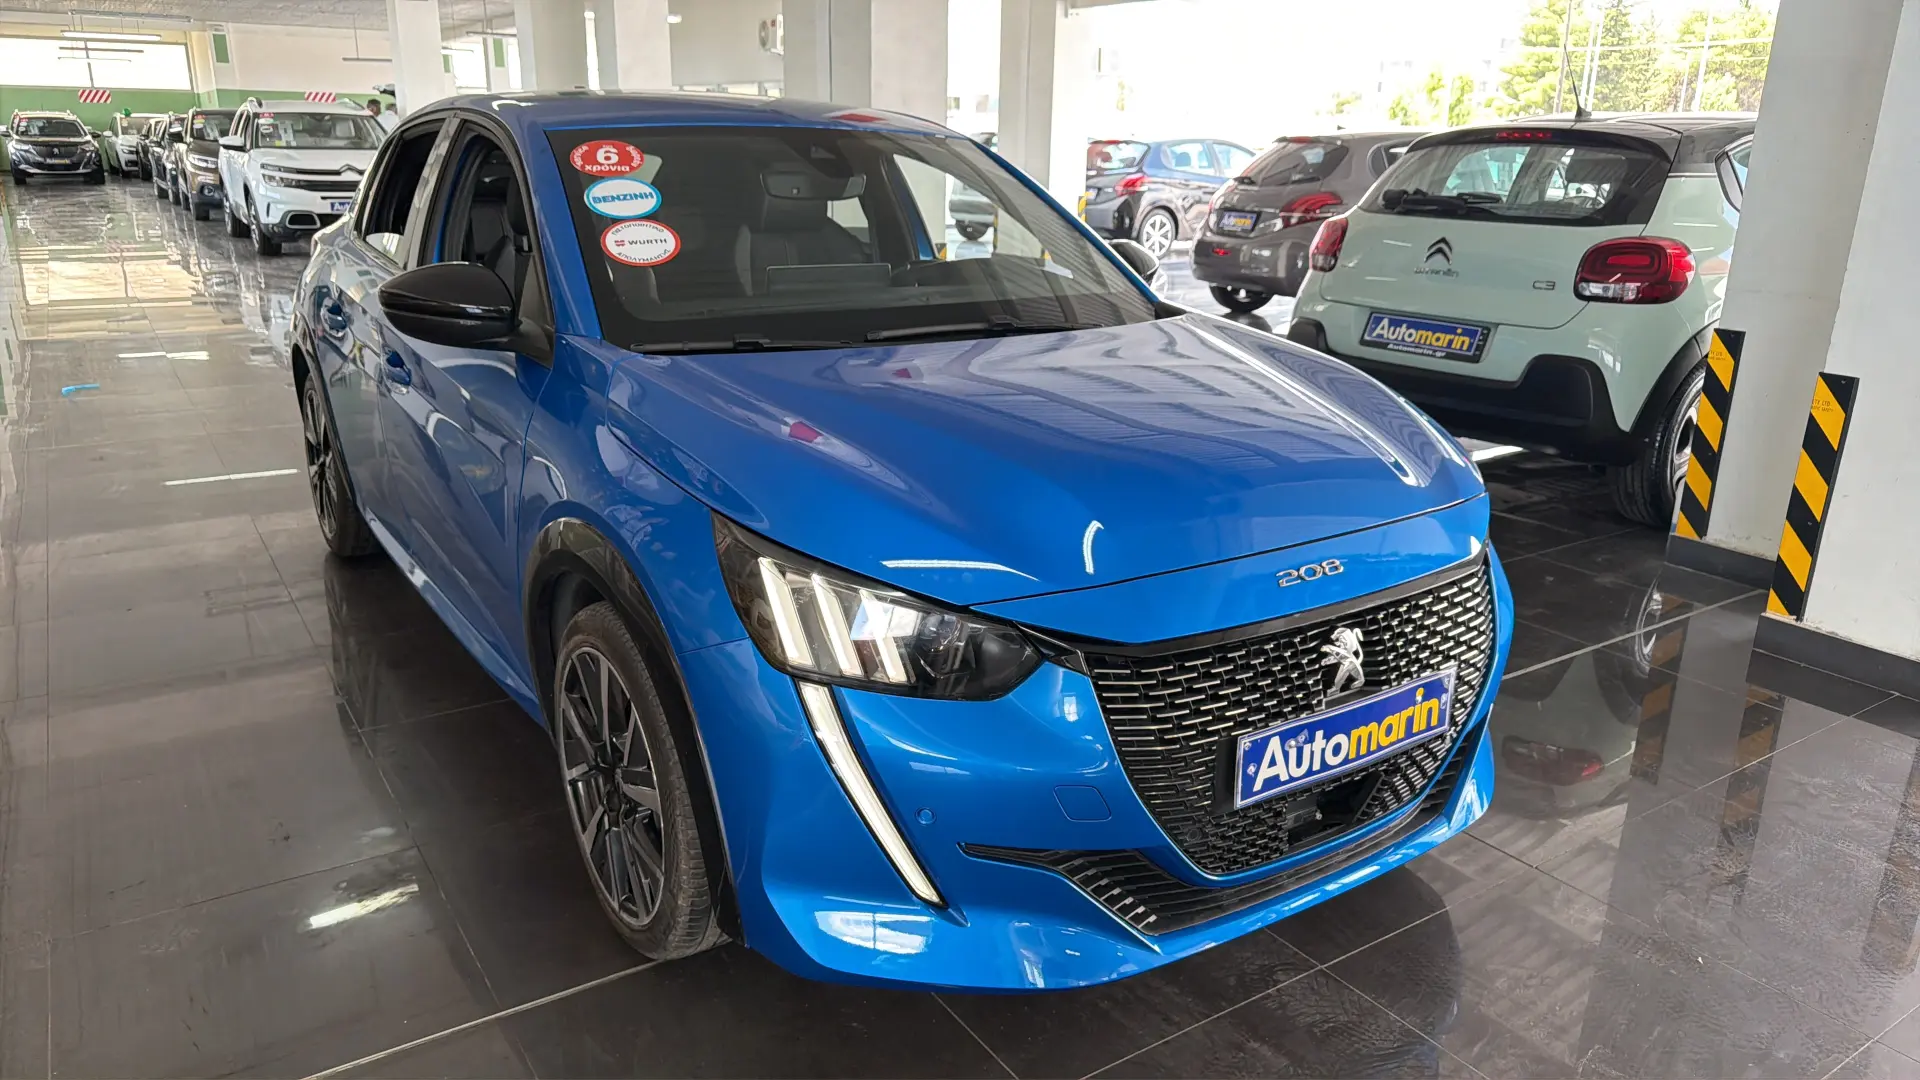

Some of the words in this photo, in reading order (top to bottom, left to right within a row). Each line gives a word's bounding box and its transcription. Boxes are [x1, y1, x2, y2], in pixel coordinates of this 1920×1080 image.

[585, 163, 630, 172] χρόνια
[596, 147, 619, 165] 6
[1532, 280, 1556, 290] C3
[1371, 317, 1470, 351] Automarin
[1276, 559, 1344, 588] 208
[1253, 687, 1440, 793] Automarin
